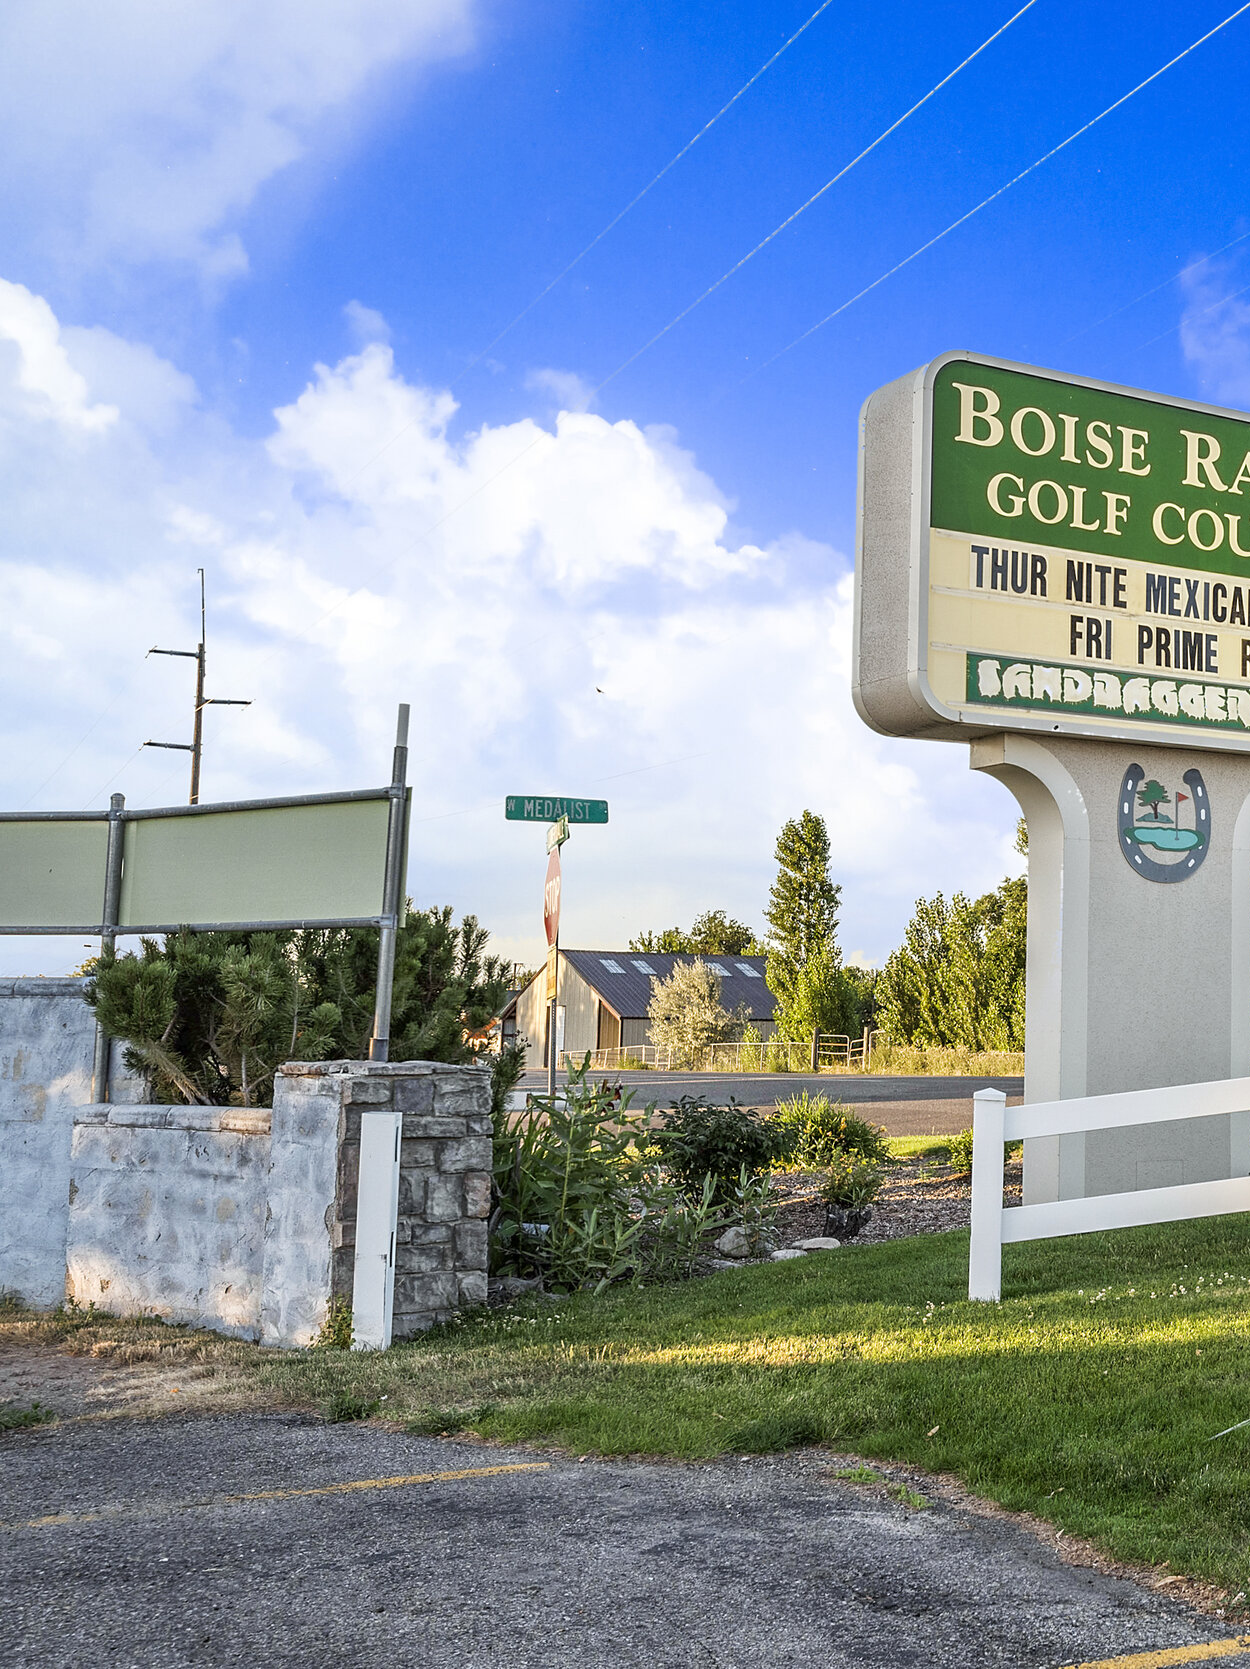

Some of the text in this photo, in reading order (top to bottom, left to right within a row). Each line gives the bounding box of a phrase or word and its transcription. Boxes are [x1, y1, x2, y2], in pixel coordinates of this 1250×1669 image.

[952, 382, 1152, 477] BOISE
[986, 472, 1131, 536] GOLF
[970, 544, 1047, 598] THUR
[1066, 559, 1127, 609] NITE
[1070, 615, 1112, 660] FRI
[1137, 624, 1218, 674] PRIME
[506, 799, 516, 811] W
[524, 799, 591, 820] MEDALIST
[545, 875, 561, 918] STOP
